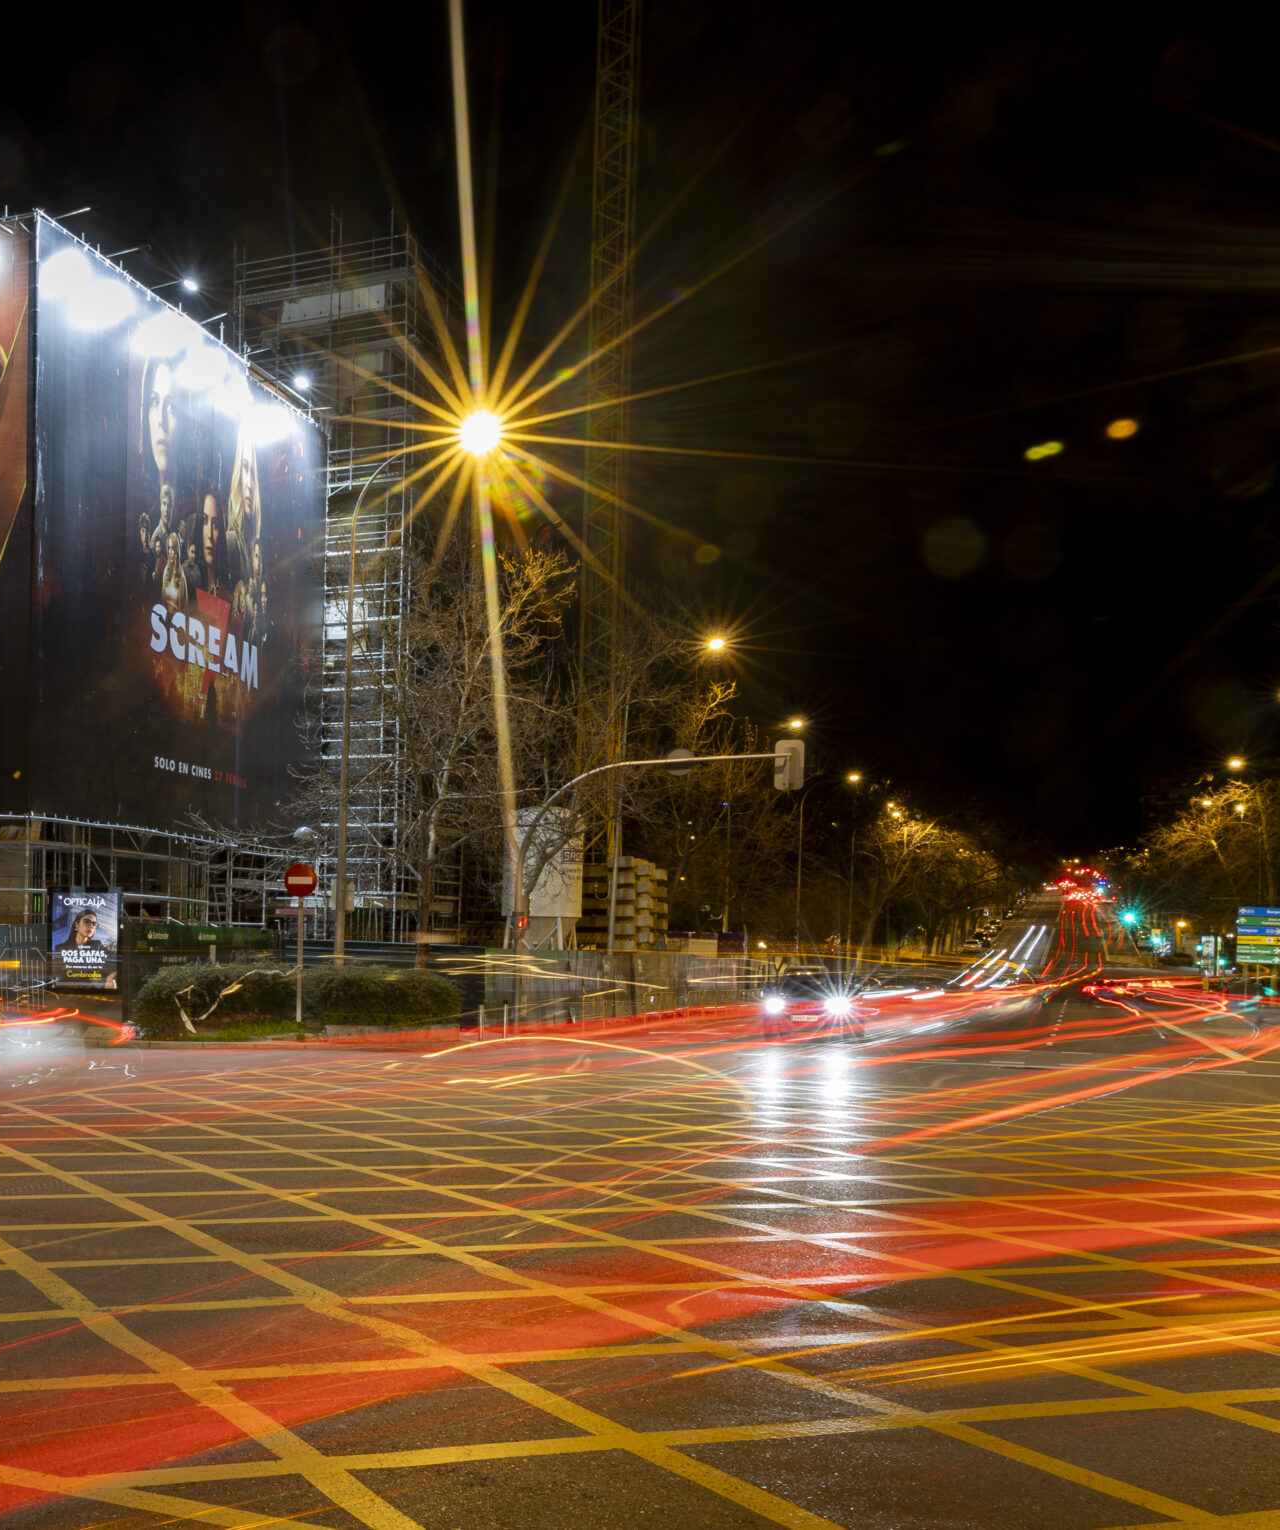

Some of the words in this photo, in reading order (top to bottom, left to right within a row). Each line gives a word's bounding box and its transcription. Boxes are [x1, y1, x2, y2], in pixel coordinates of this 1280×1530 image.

[150, 603, 258, 694] SCREAM
[154, 755, 176, 772] SOLO
[178, 761, 189, 775] EN
[191, 764, 212, 780] CINES
[79, 950, 108, 958] GAFAS,
